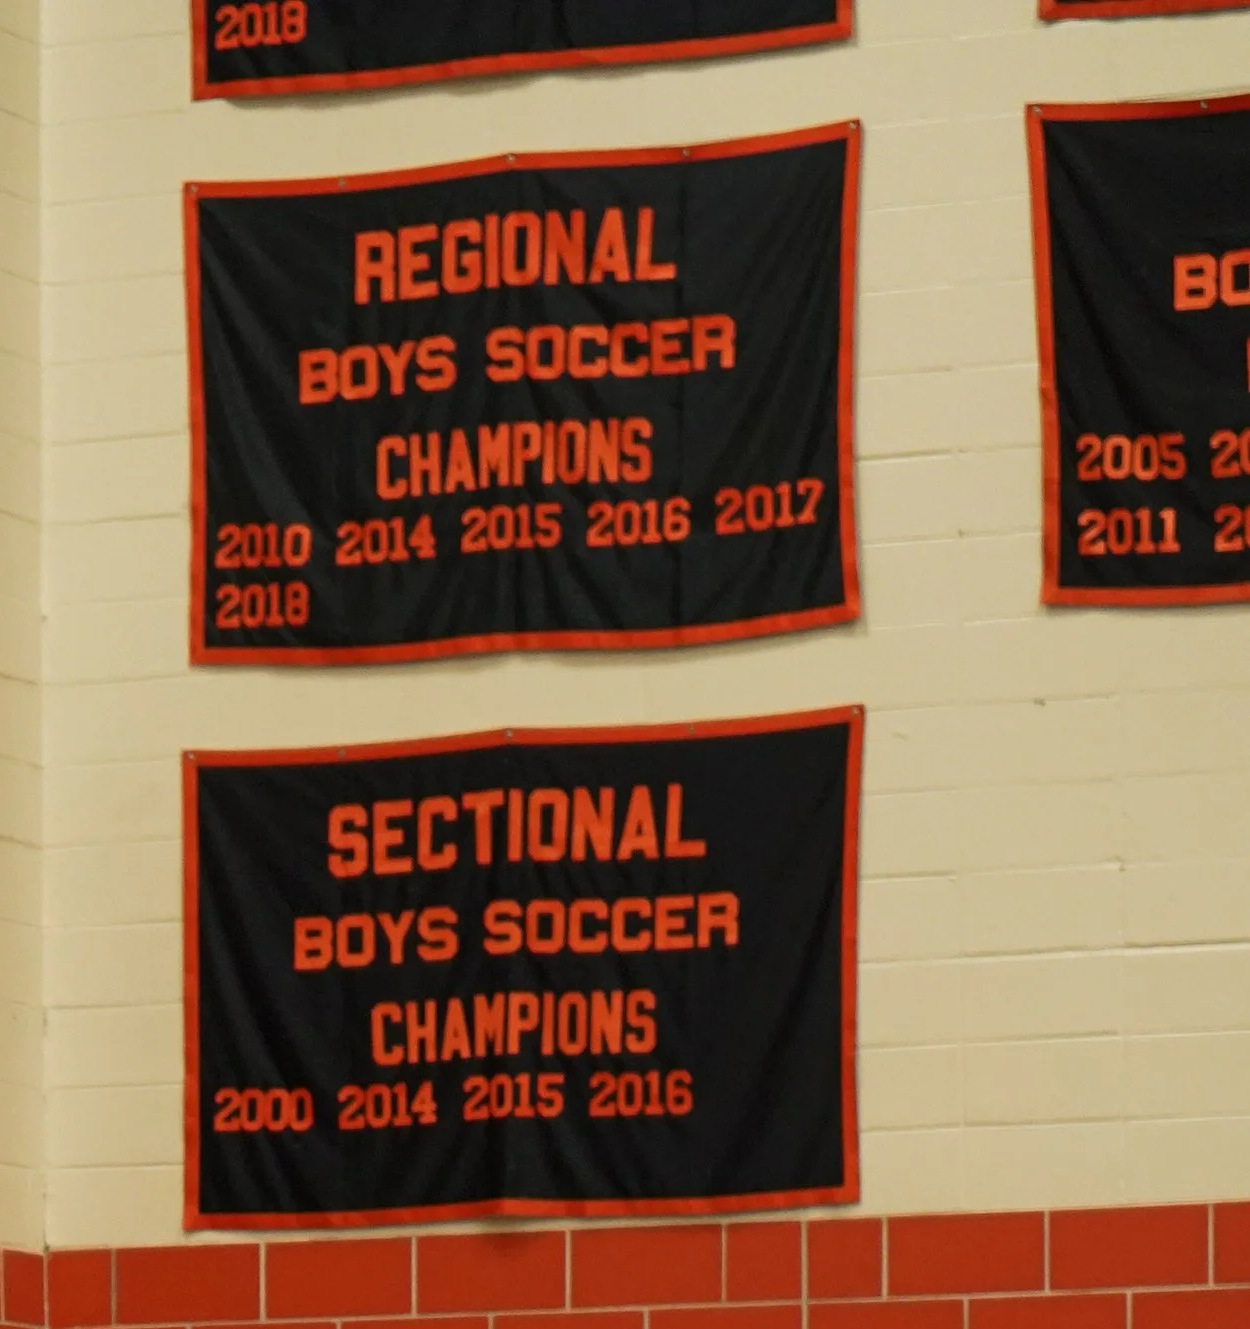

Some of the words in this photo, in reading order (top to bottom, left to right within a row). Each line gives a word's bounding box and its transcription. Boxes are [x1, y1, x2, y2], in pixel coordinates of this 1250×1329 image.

[214, 0, 307, 51] 2018
[354, 208, 677, 304] REGIONAL
[298, 335, 457, 405] BOYS
[486, 314, 736, 382] SOCCER
[376, 417, 653, 501] CHAMPIONS
[1076, 432, 1186, 481] 2005
[215, 523, 311, 569] 2010
[335, 516, 436, 566] 2014
[460, 504, 561, 554] 2015
[586, 498, 690, 548] 2016
[715, 479, 824, 535] 2017
[1078, 507, 1181, 556] 2011
[215, 582, 309, 630] 2018
[327, 784, 707, 879] SECTIONAL
[294, 907, 458, 971] BOYS
[483, 891, 739, 955] SOCCER
[371, 990, 656, 1067] CHAMPIONS
[213, 1088, 313, 1132] 2000
[338, 1082, 437, 1130] 2014
[462, 1073, 565, 1121] 2015
[588, 1070, 692, 1118] 2016
